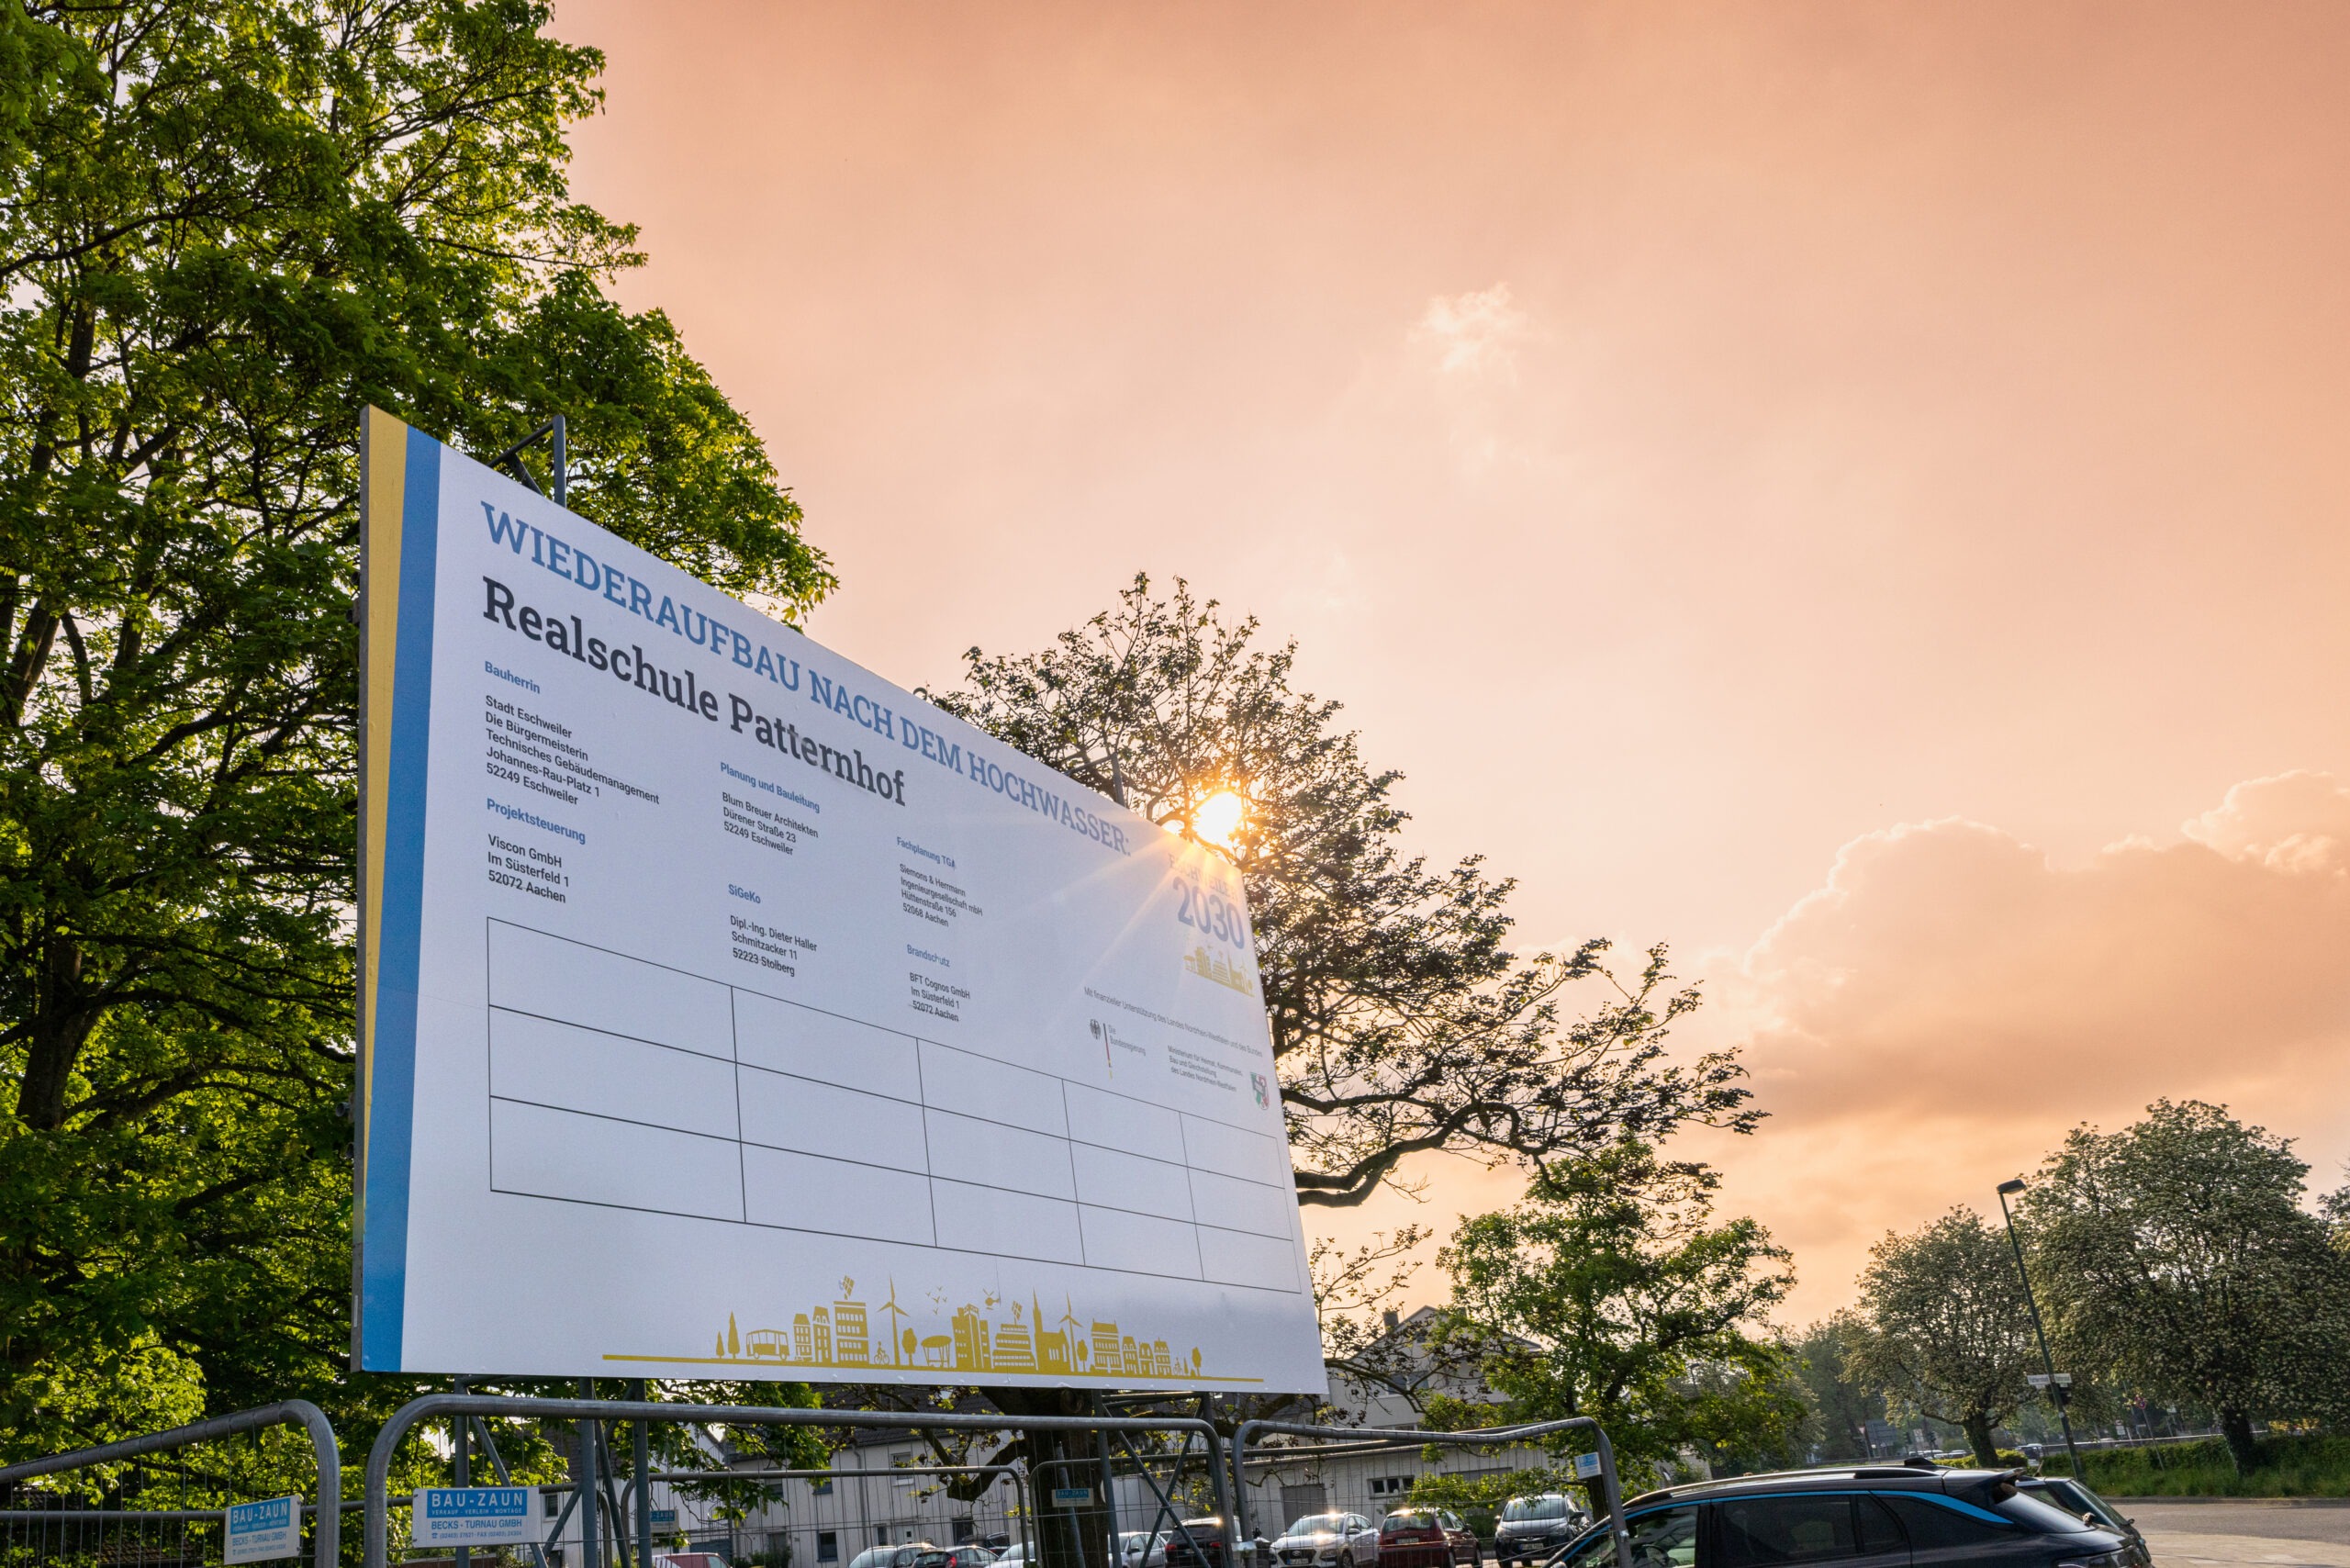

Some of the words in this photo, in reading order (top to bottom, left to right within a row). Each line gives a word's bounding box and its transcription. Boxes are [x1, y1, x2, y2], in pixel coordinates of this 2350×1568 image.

[481, 500, 800, 691] WIEDERAUFBAU
[809, 669, 894, 741] NACH
[900, 716, 964, 774] DEM
[967, 751, 1131, 857] HOCHWASSER:
[482, 576, 718, 722] Realschule
[729, 693, 905, 806] Patternhof
[485, 660, 541, 694] Bauherrin
[486, 695, 514, 716] Stadt
[518, 708, 572, 739] Eschweiler
[486, 711, 503, 728] Die
[506, 720, 588, 761] Bürgermeisterin
[487, 728, 552, 763] Technisches
[554, 755, 660, 804] Gebäudemanagement
[487, 746, 591, 794] Johannes-Rau-Platz
[594, 787, 599, 797] 1
[487, 763, 520, 783] 52249
[523, 777, 578, 805] Eschweiler
[721, 762, 756, 788] Planung
[758, 779, 774, 793] und
[777, 786, 820, 813] Bauleitung
[487, 798, 586, 845] Projektsteuerung
[722, 791, 744, 809] Blum
[745, 801, 772, 820] Breuer
[774, 813, 818, 838] Architekten
[723, 807, 755, 827] Dürener
[757, 821, 784, 839] Straße
[786, 832, 796, 843] 23
[487, 834, 526, 857] Viscon
[529, 847, 562, 868] GmbH
[723, 822, 749, 838] 52249
[752, 832, 793, 855] Eschweiler
[897, 836, 940, 864] Fachplanung
[487, 852, 502, 866] Im
[506, 857, 560, 885] Süsterfeld
[564, 876, 569, 887] 1
[488, 870, 523, 890] 52072
[526, 882, 565, 903] Aachen
[929, 875, 934, 884] &
[728, 883, 761, 904] SiGeKo
[924, 911, 948, 927] Aachen
[1172, 877, 1245, 949] 2030
[732, 931, 787, 957] Schmitzacker
[789, 949, 797, 959] 11
[769, 927, 792, 944] Dieter
[794, 935, 817, 951] Haller
[907, 944, 950, 967] Brandschutz
[733, 947, 759, 964] 52223
[761, 957, 795, 977] Stolberg
[934, 1007, 959, 1022] Aachen
[431, 1520, 458, 1529] BECKS
[465, 1519, 497, 1529] TURNAU
[498, 1519, 522, 1528] GMBH
